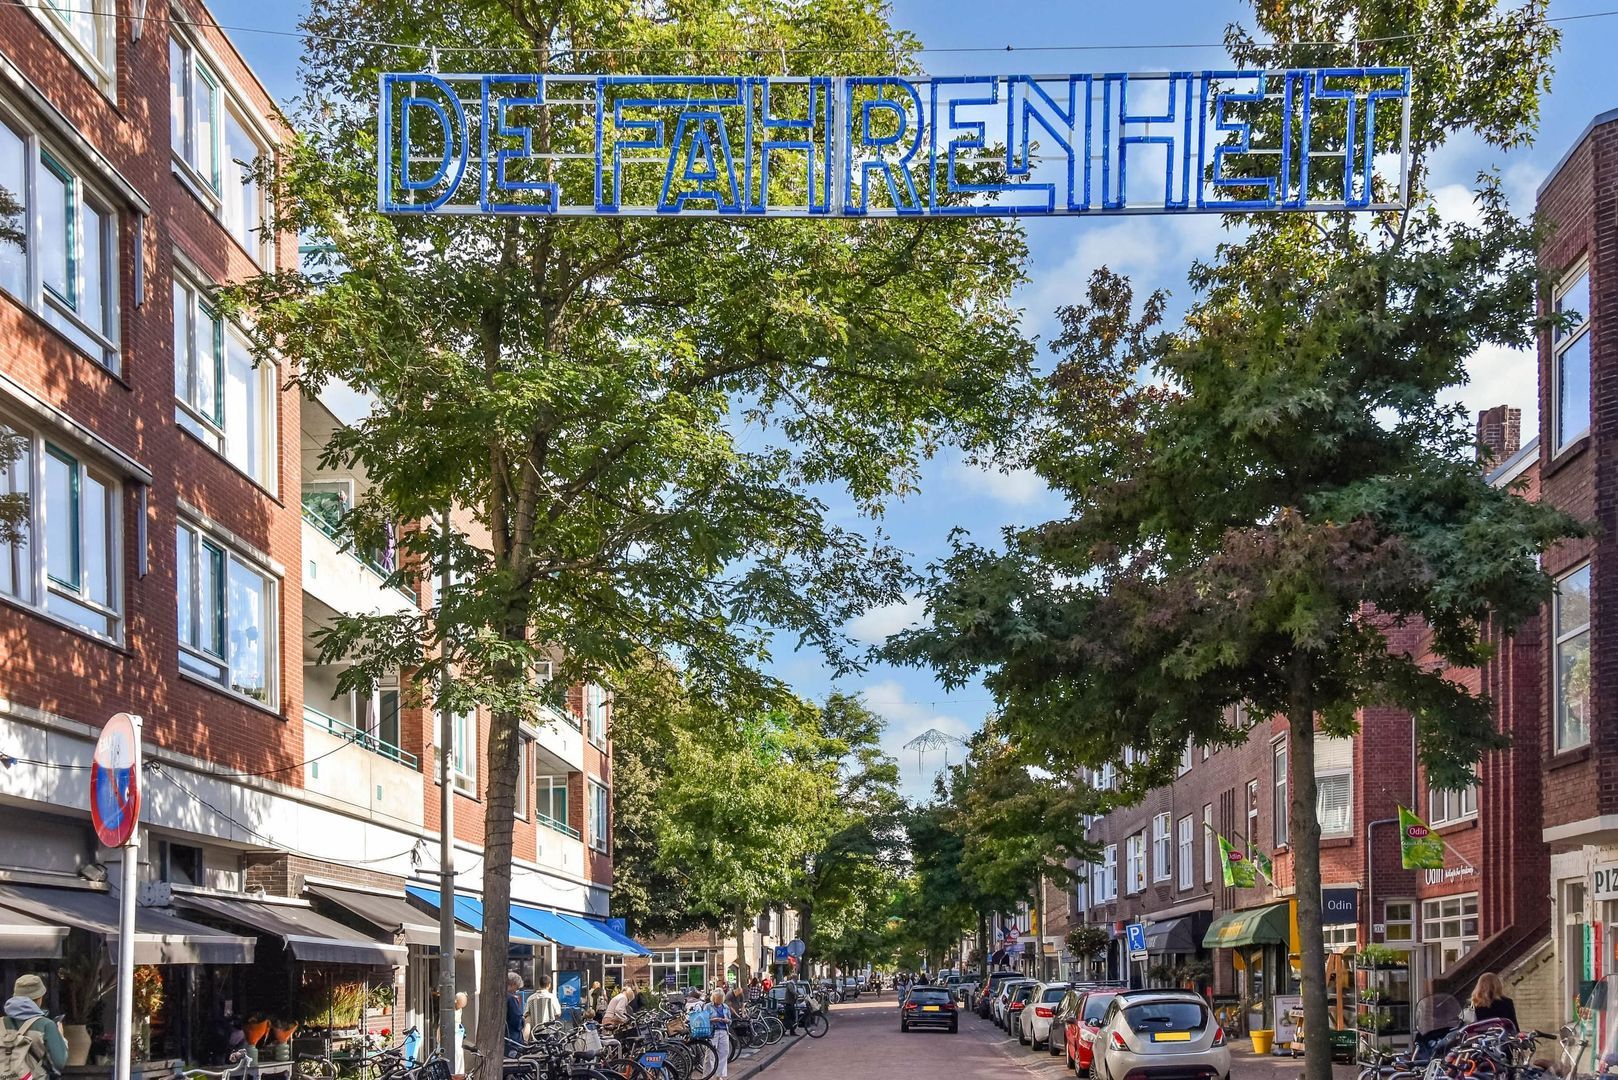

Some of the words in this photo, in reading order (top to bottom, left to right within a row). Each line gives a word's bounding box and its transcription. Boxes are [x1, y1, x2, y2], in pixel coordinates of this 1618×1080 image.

[384, 73, 559, 213] DE
[594, 66, 1411, 214] FAHRENHEIT
[1409, 826, 1428, 836] Odin
[1327, 900, 1352, 910] Odin
[1130, 927, 1139, 941] P
